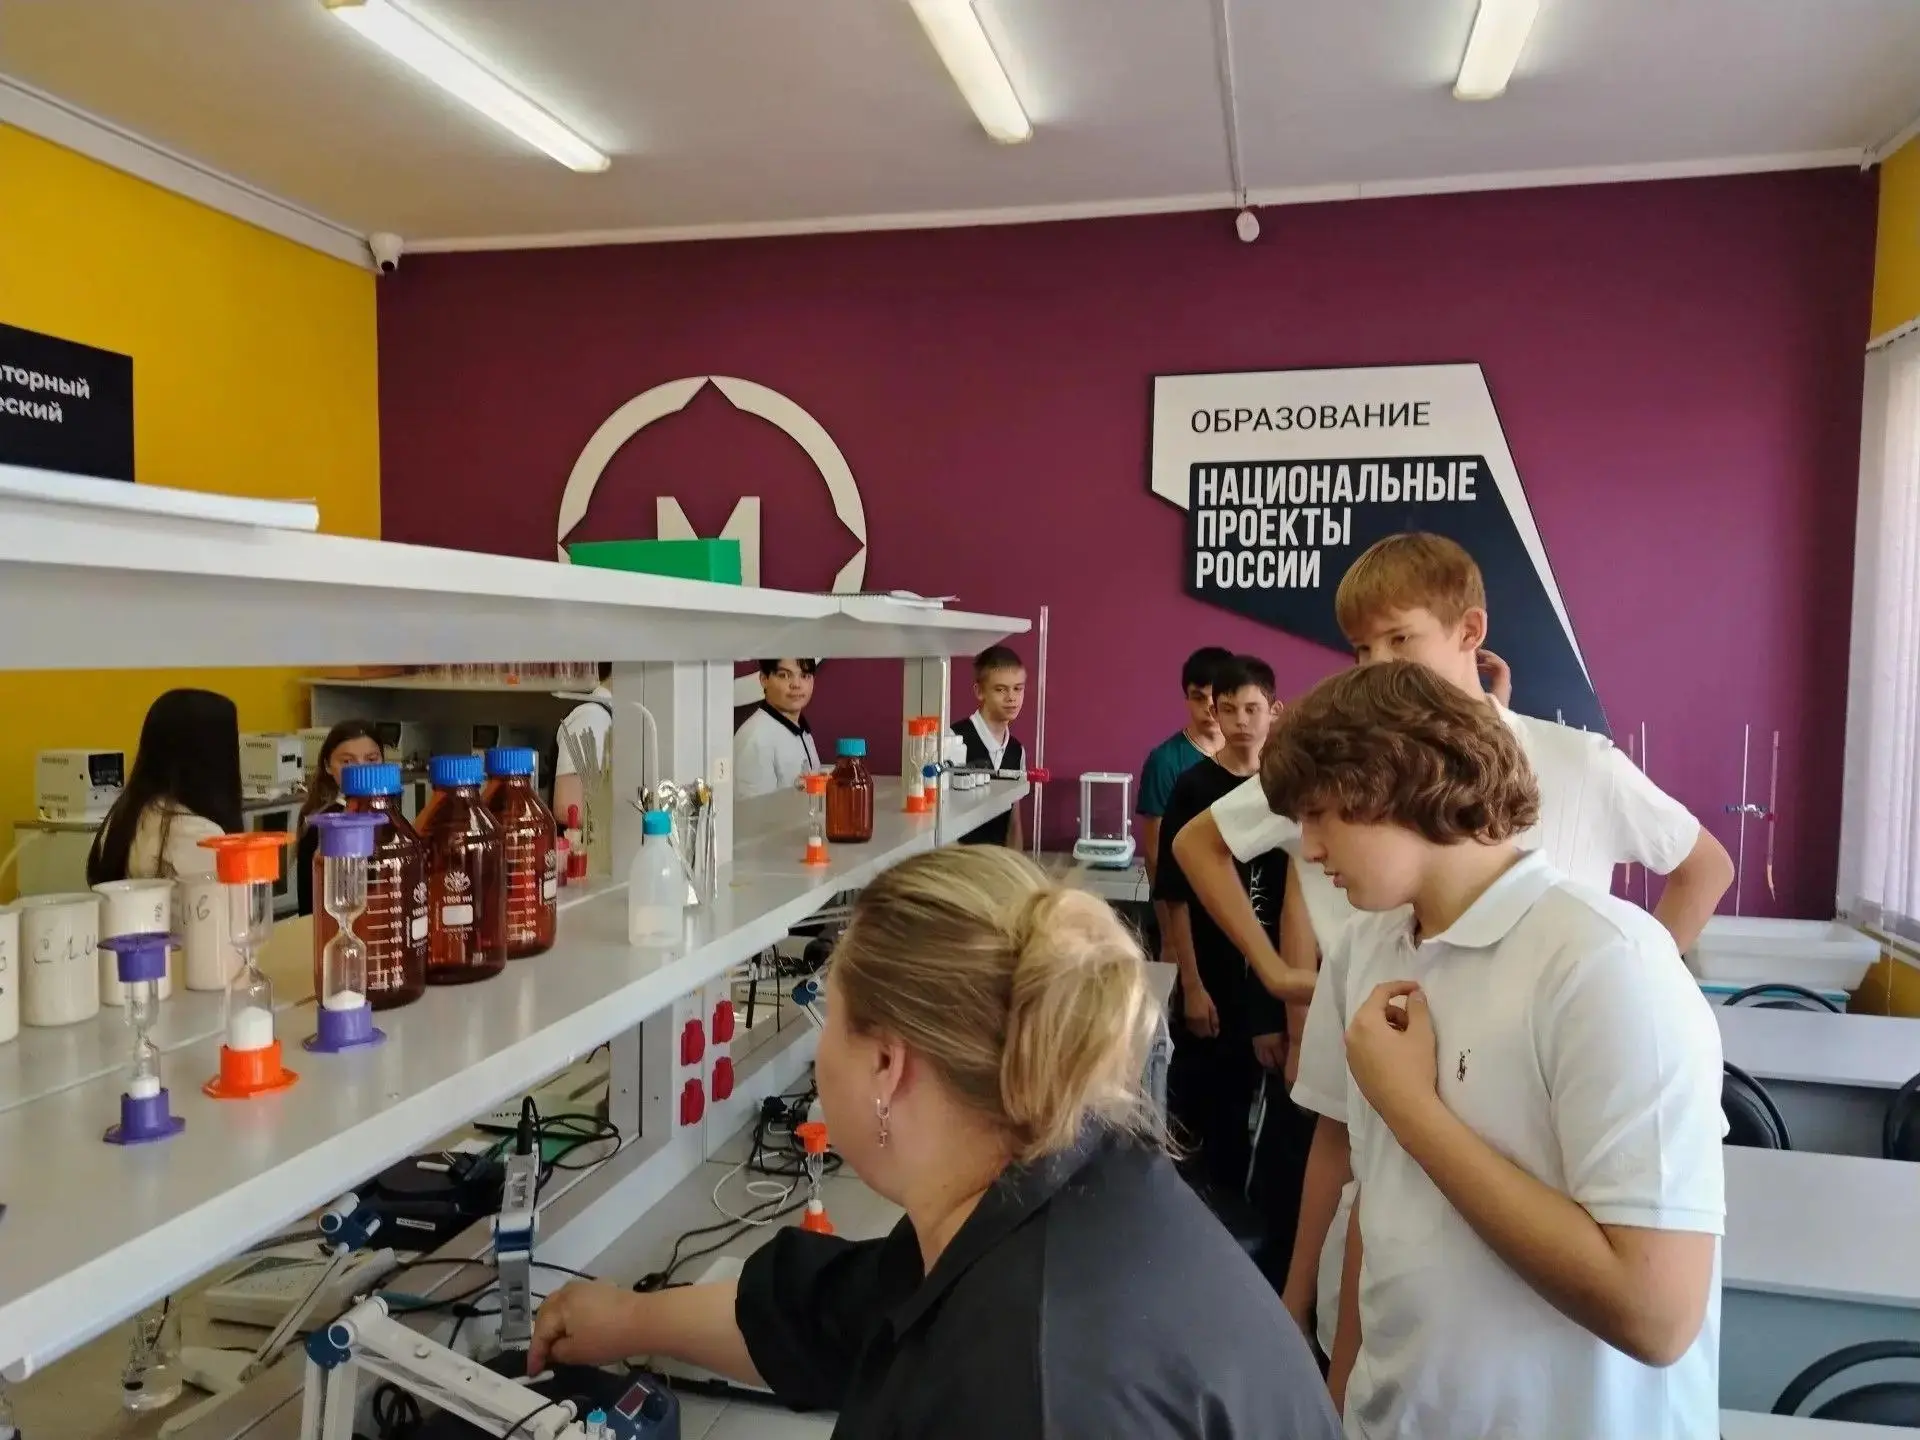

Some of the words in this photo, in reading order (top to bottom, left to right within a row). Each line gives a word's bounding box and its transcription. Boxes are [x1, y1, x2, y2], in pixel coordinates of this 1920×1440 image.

[0, 364, 90, 400] торный
[1190, 400, 1432, 434] ОБРАЗОВАНИЕ
[1198, 461, 1479, 509] НАЦИОНАЛЬНЫЕ
[1197, 506, 1352, 548] ПРОЕКТЫ
[1195, 550, 1321, 589] РОССИИ
